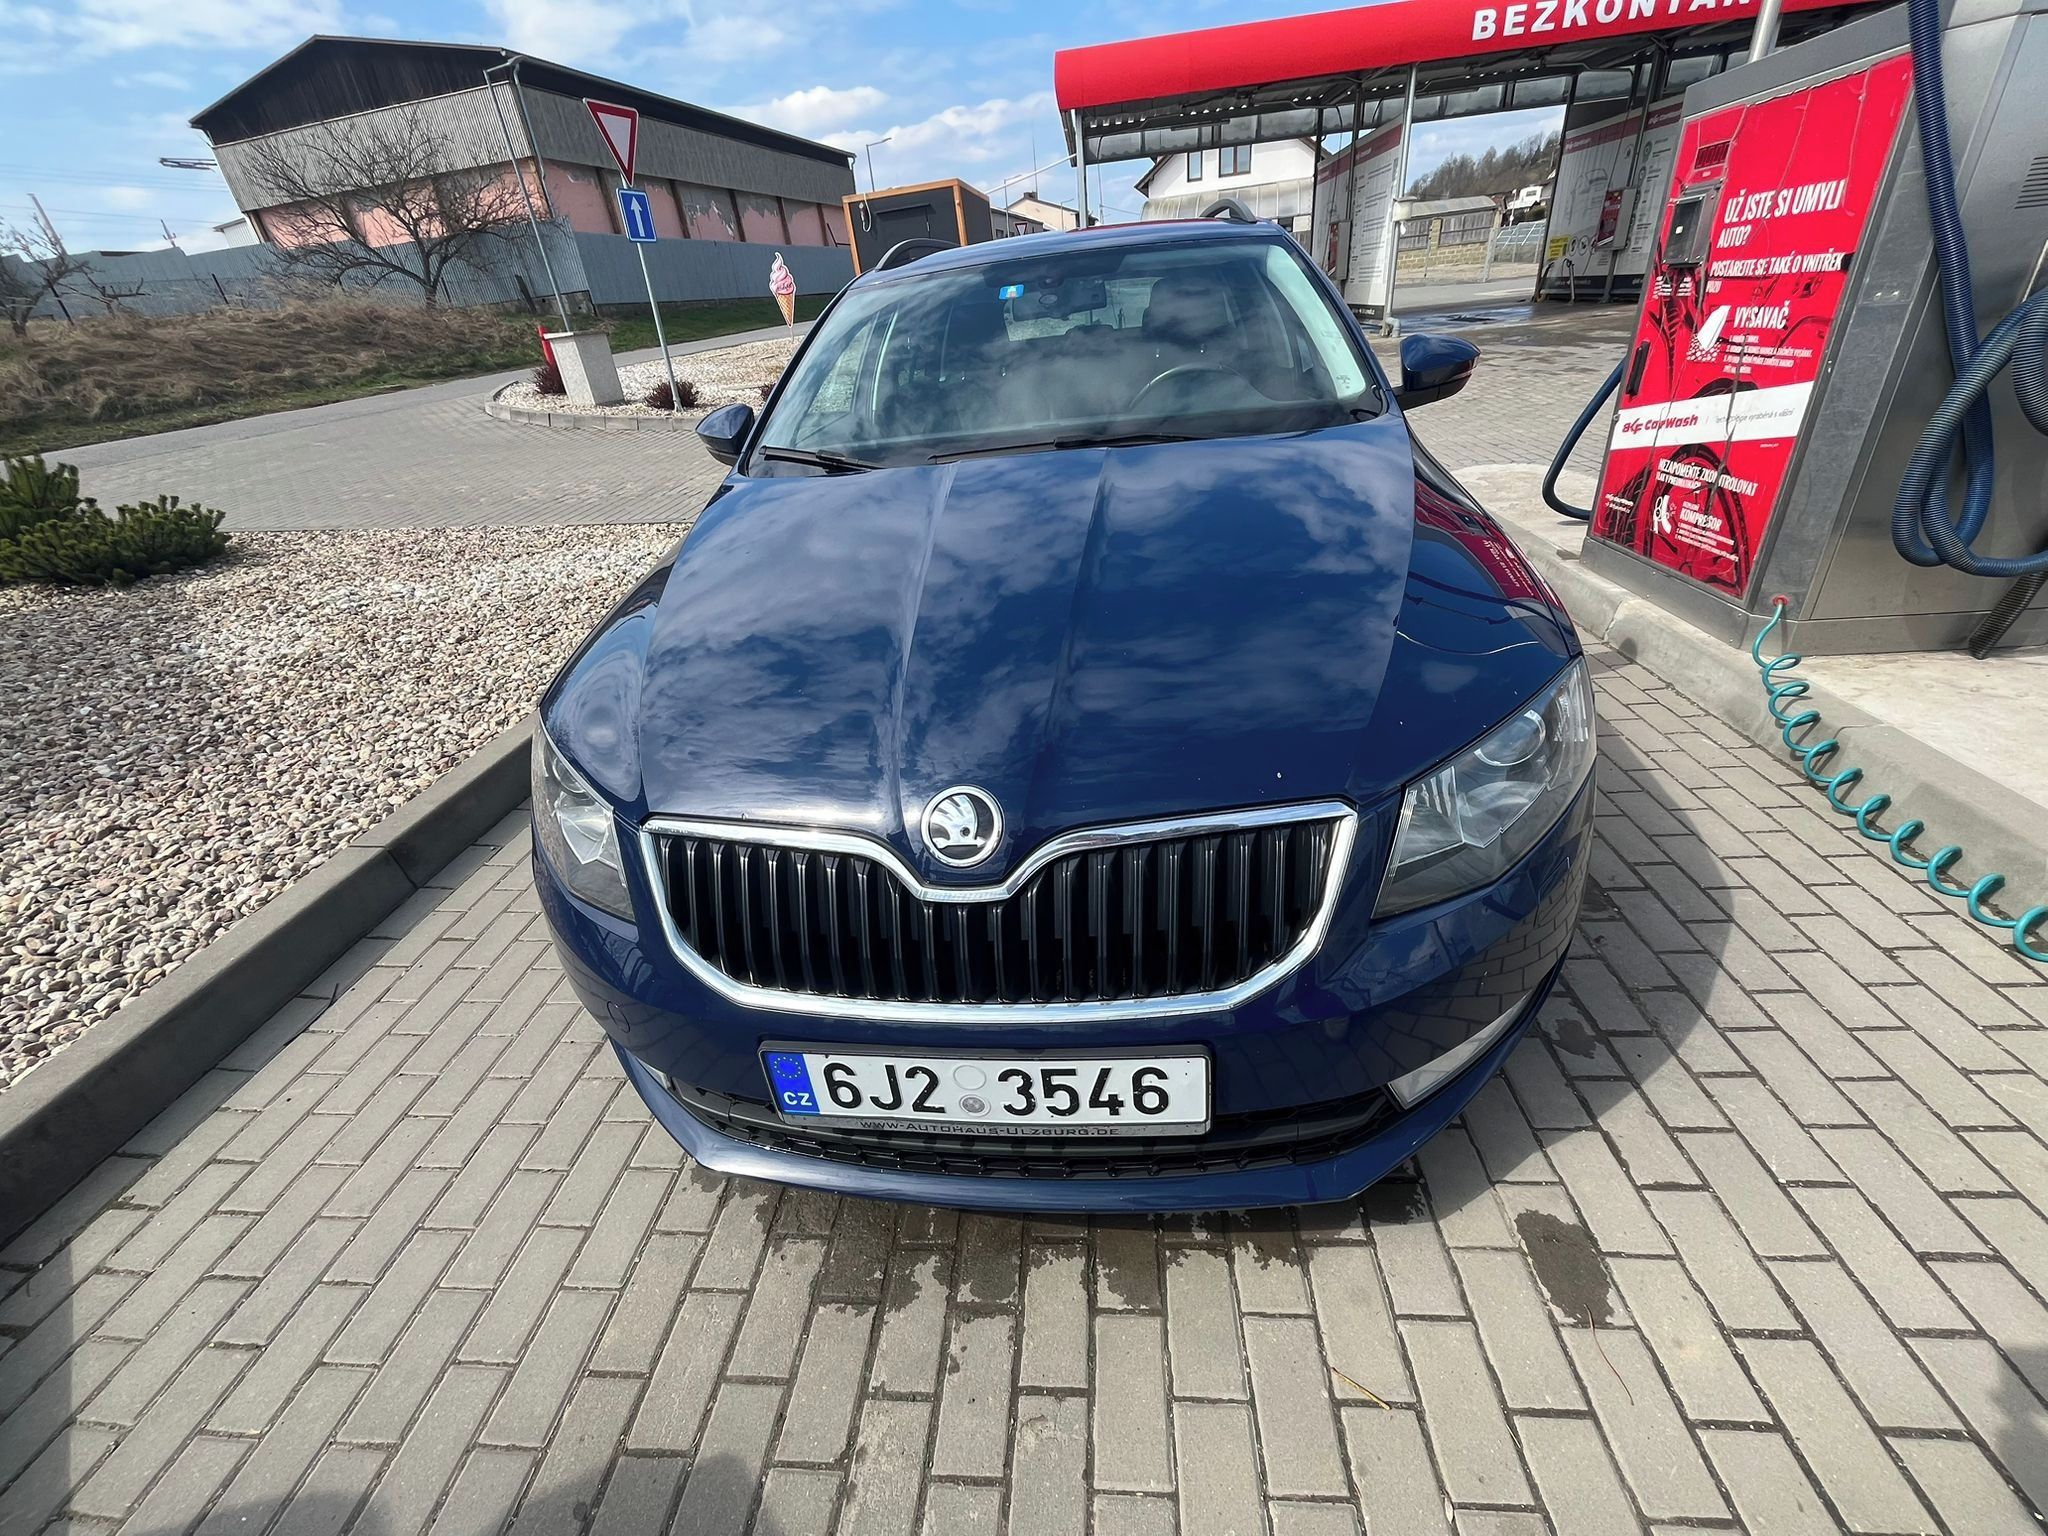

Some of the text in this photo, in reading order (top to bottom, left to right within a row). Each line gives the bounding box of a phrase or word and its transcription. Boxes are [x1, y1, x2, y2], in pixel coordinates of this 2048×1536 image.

[1472, 0, 1749, 41] BEZKON
[1724, 179, 1846, 224] UŽ JSTE SI UMYLI
[1716, 224, 1751, 248] AUTO?
[1709, 248, 1846, 277] POSTAREJTE SE TAKÉ O VNITŘEK
[1733, 300, 1791, 329] VYSAVAČ
[1657, 458, 1702, 481] NEZAPOMEŇTE
[1679, 507, 1722, 532] KOMPRESOR
[783, 1091, 813, 1106] CZ
[822, 1062, 1169, 1117] 6J2 3546
